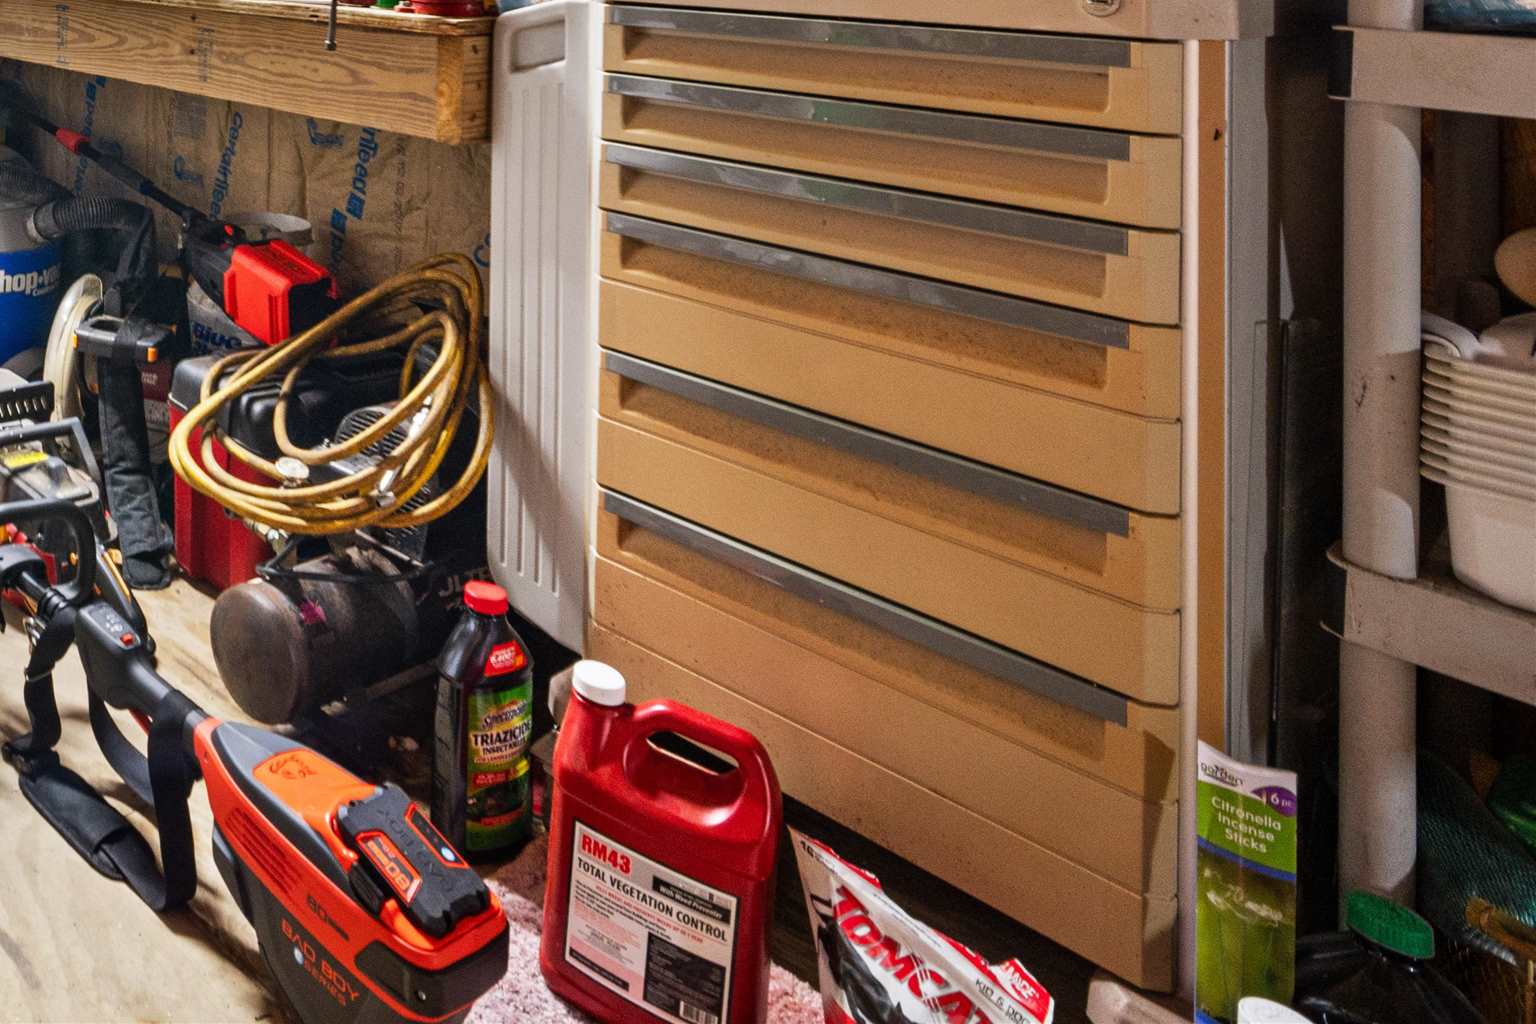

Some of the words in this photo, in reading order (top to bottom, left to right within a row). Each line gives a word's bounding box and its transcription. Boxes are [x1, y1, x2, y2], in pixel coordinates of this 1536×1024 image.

[1211, 796, 1281, 832] Citronella
[1270, 792, 1280, 805] 6
[1218, 812, 1275, 842] Incense
[1225, 828, 1267, 854] Sticks
[581, 834, 631, 874] RM43
[577, 857, 607, 882] TOTAL
[610, 874, 673, 918] VEGETATION
[676, 910, 728, 943] CONTROL
